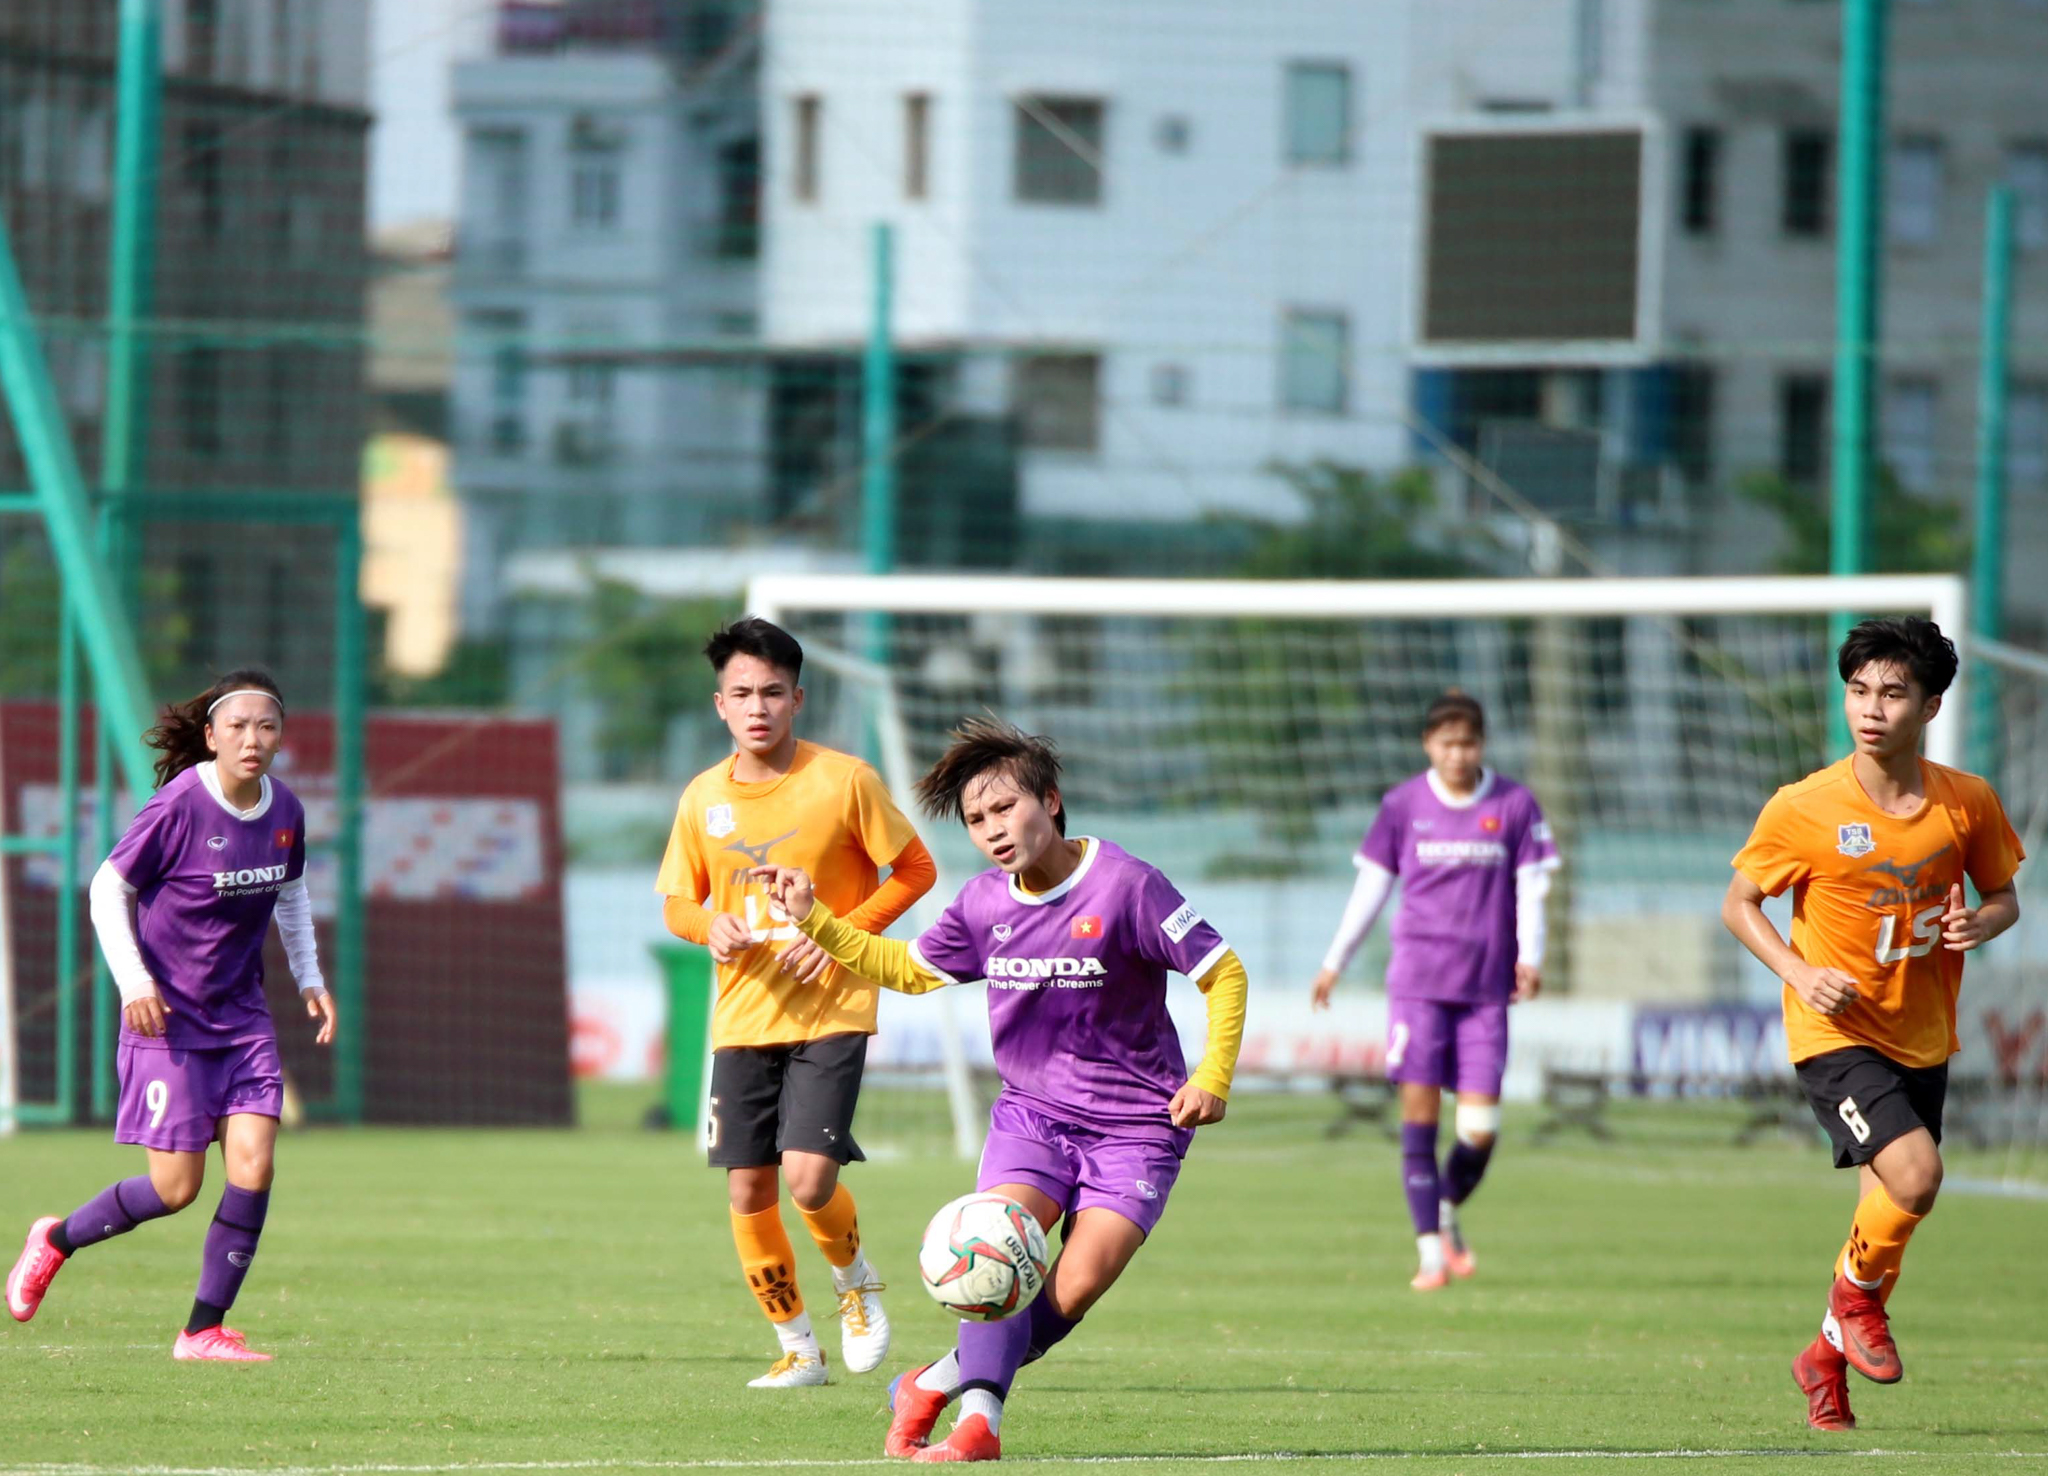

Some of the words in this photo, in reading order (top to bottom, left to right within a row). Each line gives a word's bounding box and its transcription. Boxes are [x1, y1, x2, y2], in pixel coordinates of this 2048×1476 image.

[213, 864, 287, 888] HOND
[217, 890, 236, 898] The
[236, 886, 264, 896] Power
[265, 884, 275, 893] of
[1875, 904, 1945, 964] LS
[987, 957, 1108, 978] HONDA
[990, 979, 1007, 990] The
[1008, 980, 1040, 991] Power
[1042, 979, 1055, 988] of
[1057, 979, 1104, 989] Dreams
[146, 1080, 167, 1128] 9
[1839, 1095, 1870, 1144] 6
[1005, 1236, 1036, 1290] molten
